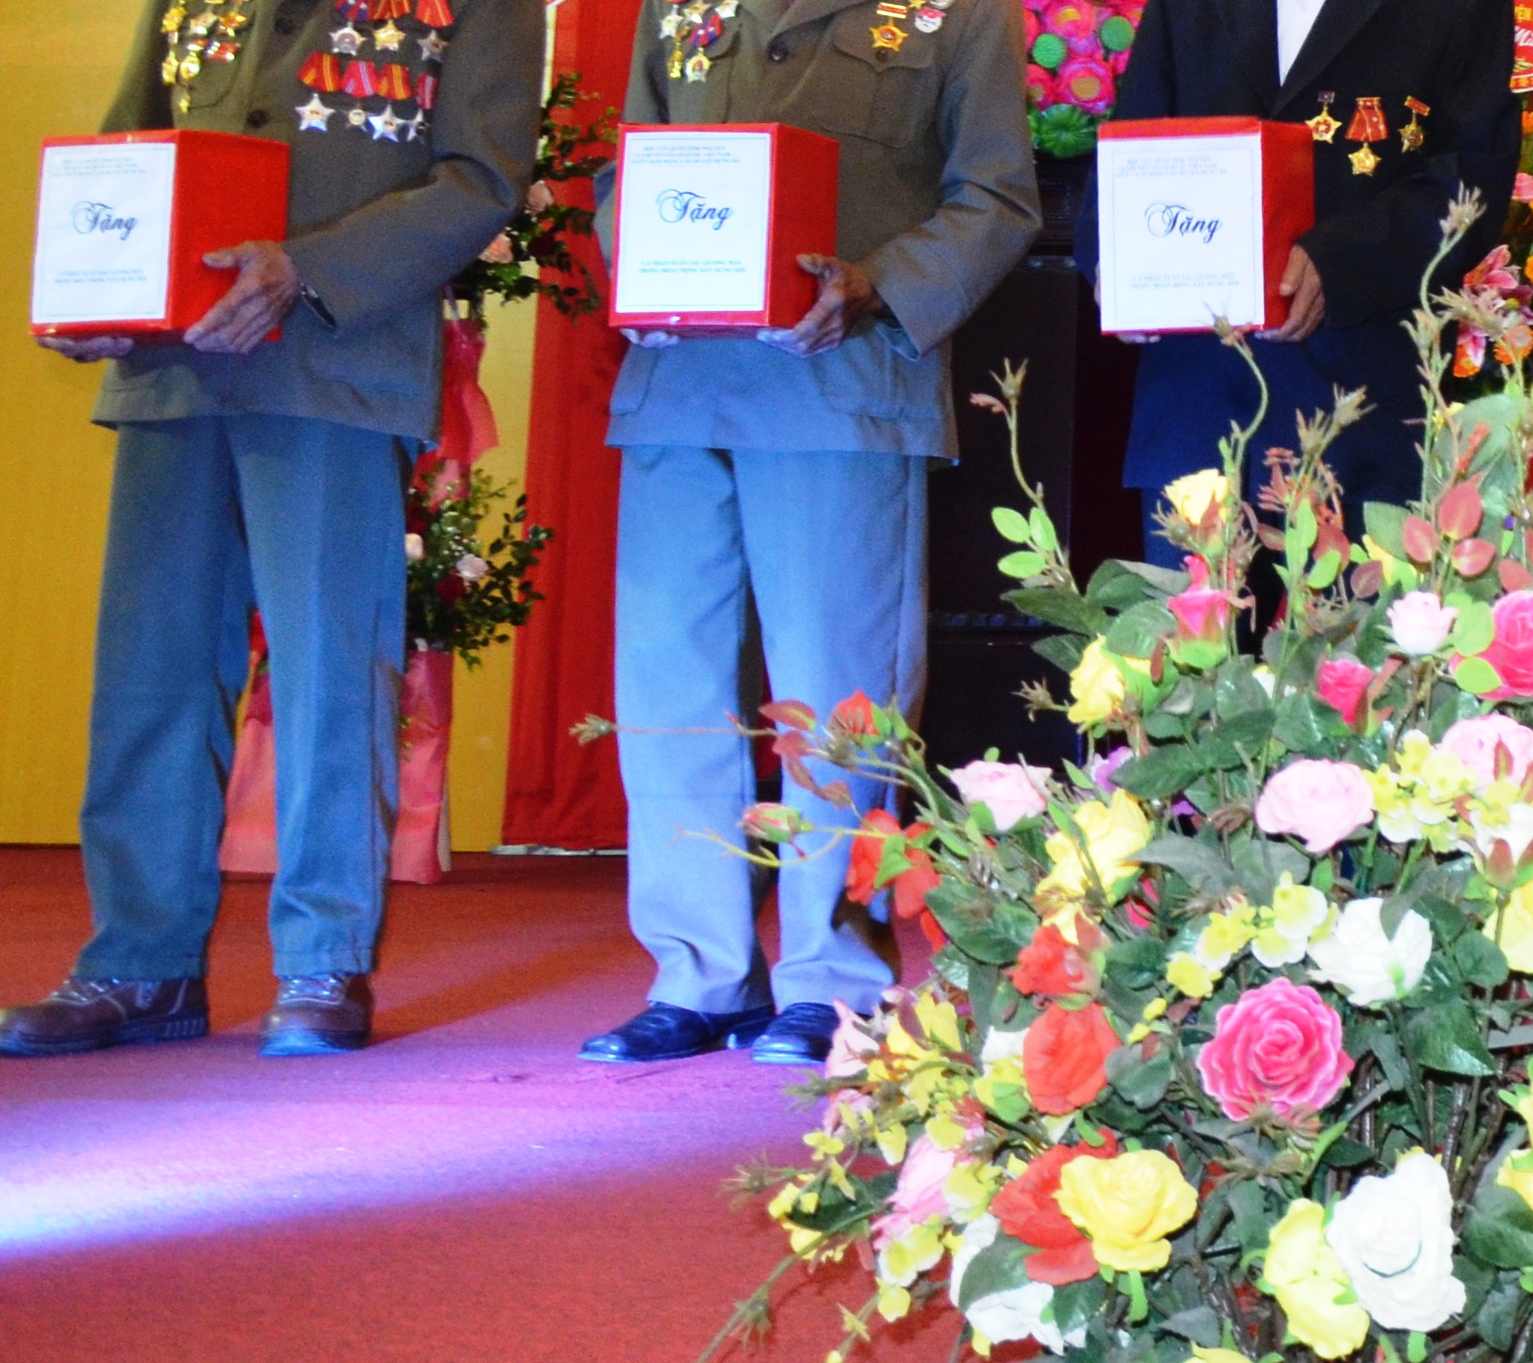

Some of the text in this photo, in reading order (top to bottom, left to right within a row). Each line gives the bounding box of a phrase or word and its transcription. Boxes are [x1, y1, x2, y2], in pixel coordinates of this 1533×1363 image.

[71, 200, 138, 241] Tặng
[656, 188, 734, 231] Tặng
[1144, 202, 1223, 244] Tặng
